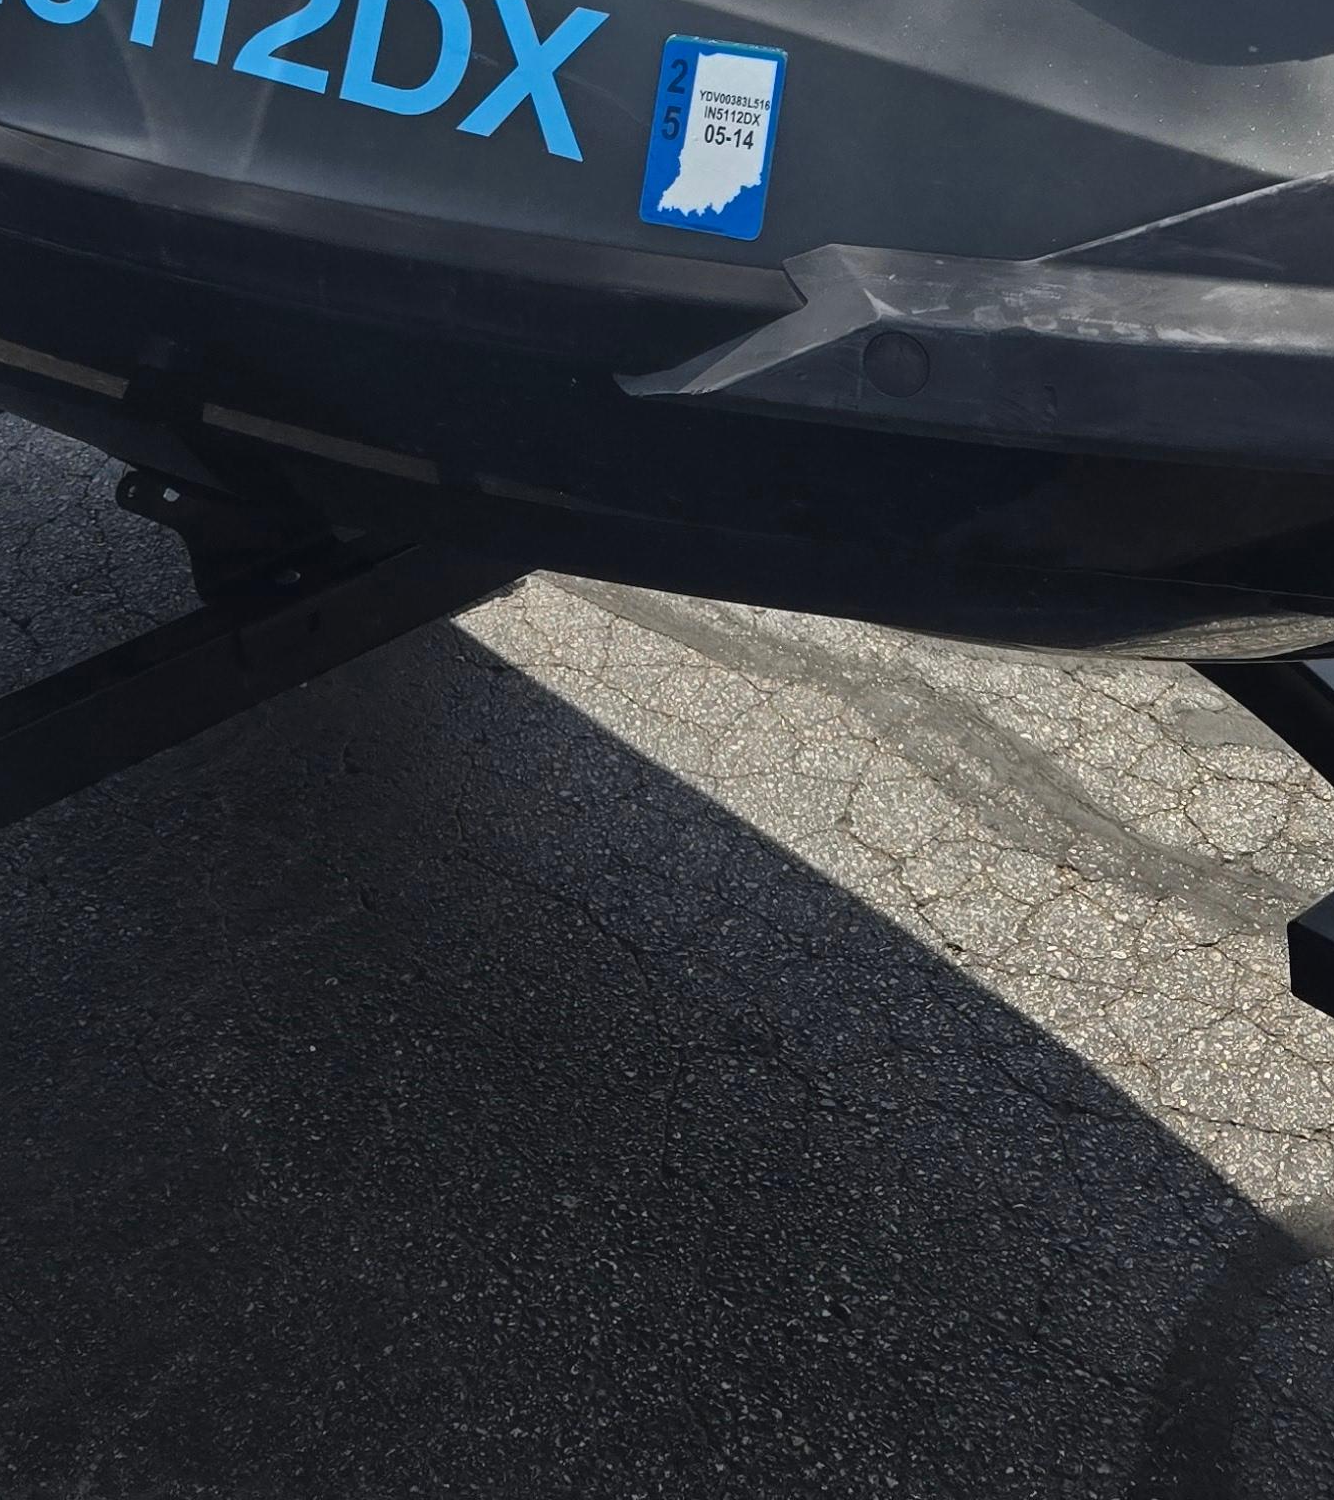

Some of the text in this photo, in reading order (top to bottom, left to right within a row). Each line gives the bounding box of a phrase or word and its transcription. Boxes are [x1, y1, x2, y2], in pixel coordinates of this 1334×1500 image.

[699, 89, 771, 111] YDV00383L516
[704, 105, 762, 127] IN5112DX
[704, 123, 755, 150] 05-14
